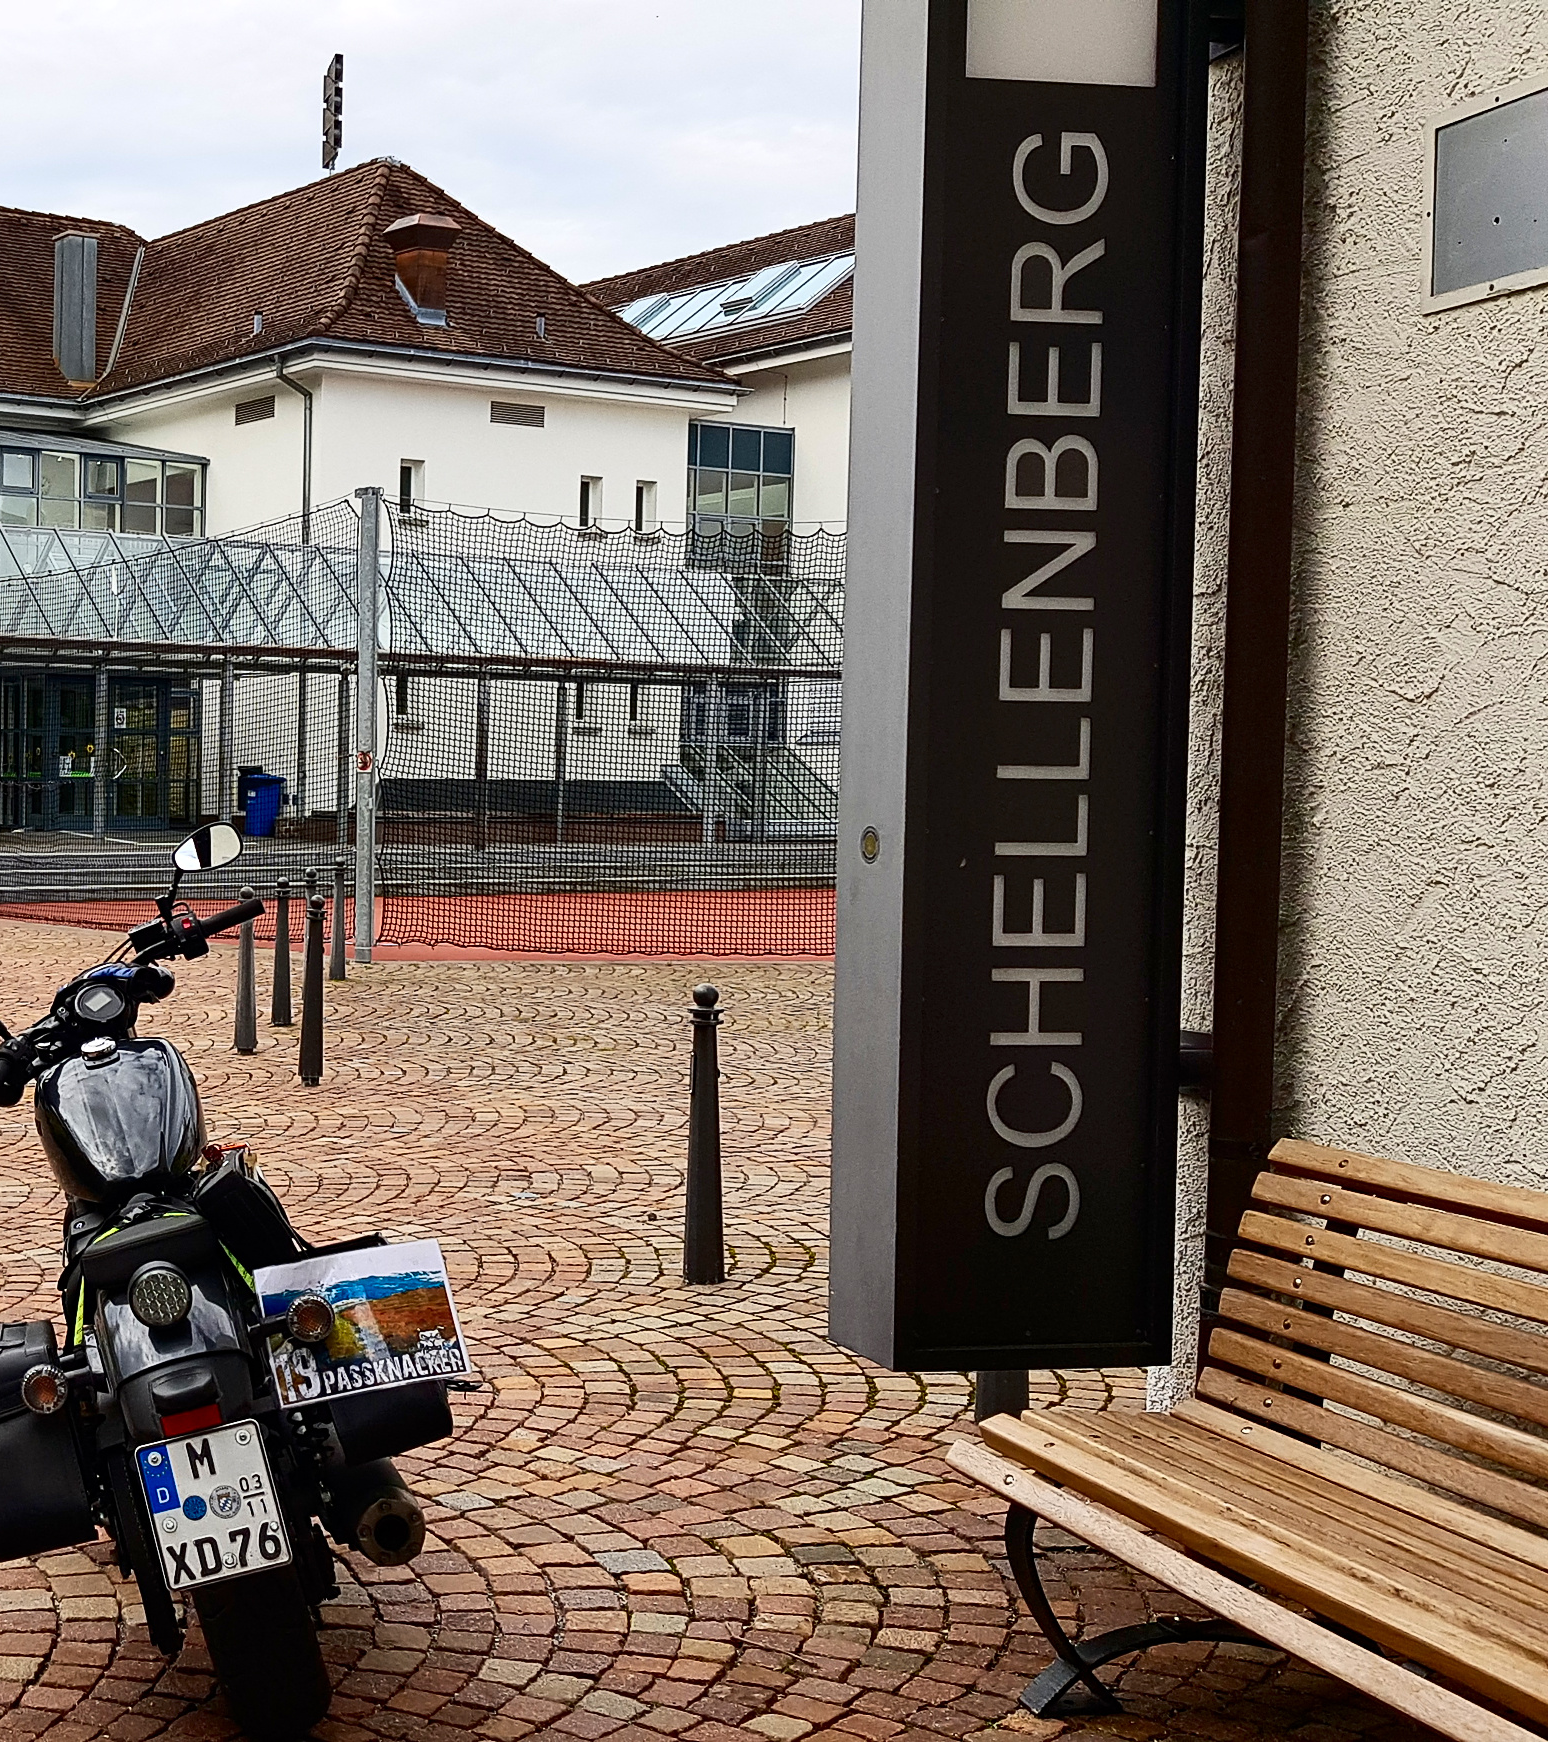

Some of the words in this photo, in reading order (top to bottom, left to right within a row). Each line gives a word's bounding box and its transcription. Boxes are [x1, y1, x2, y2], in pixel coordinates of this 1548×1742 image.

[984, 130, 1110, 1240] SCHELLENBERG
[322, 1348, 465, 1395] PASSKNACKER
[185, 1437, 217, 1480] M
[156, 1487, 170, 1504] D
[238, 1473, 263, 1493] 03
[246, 1498, 268, 1518] 11
